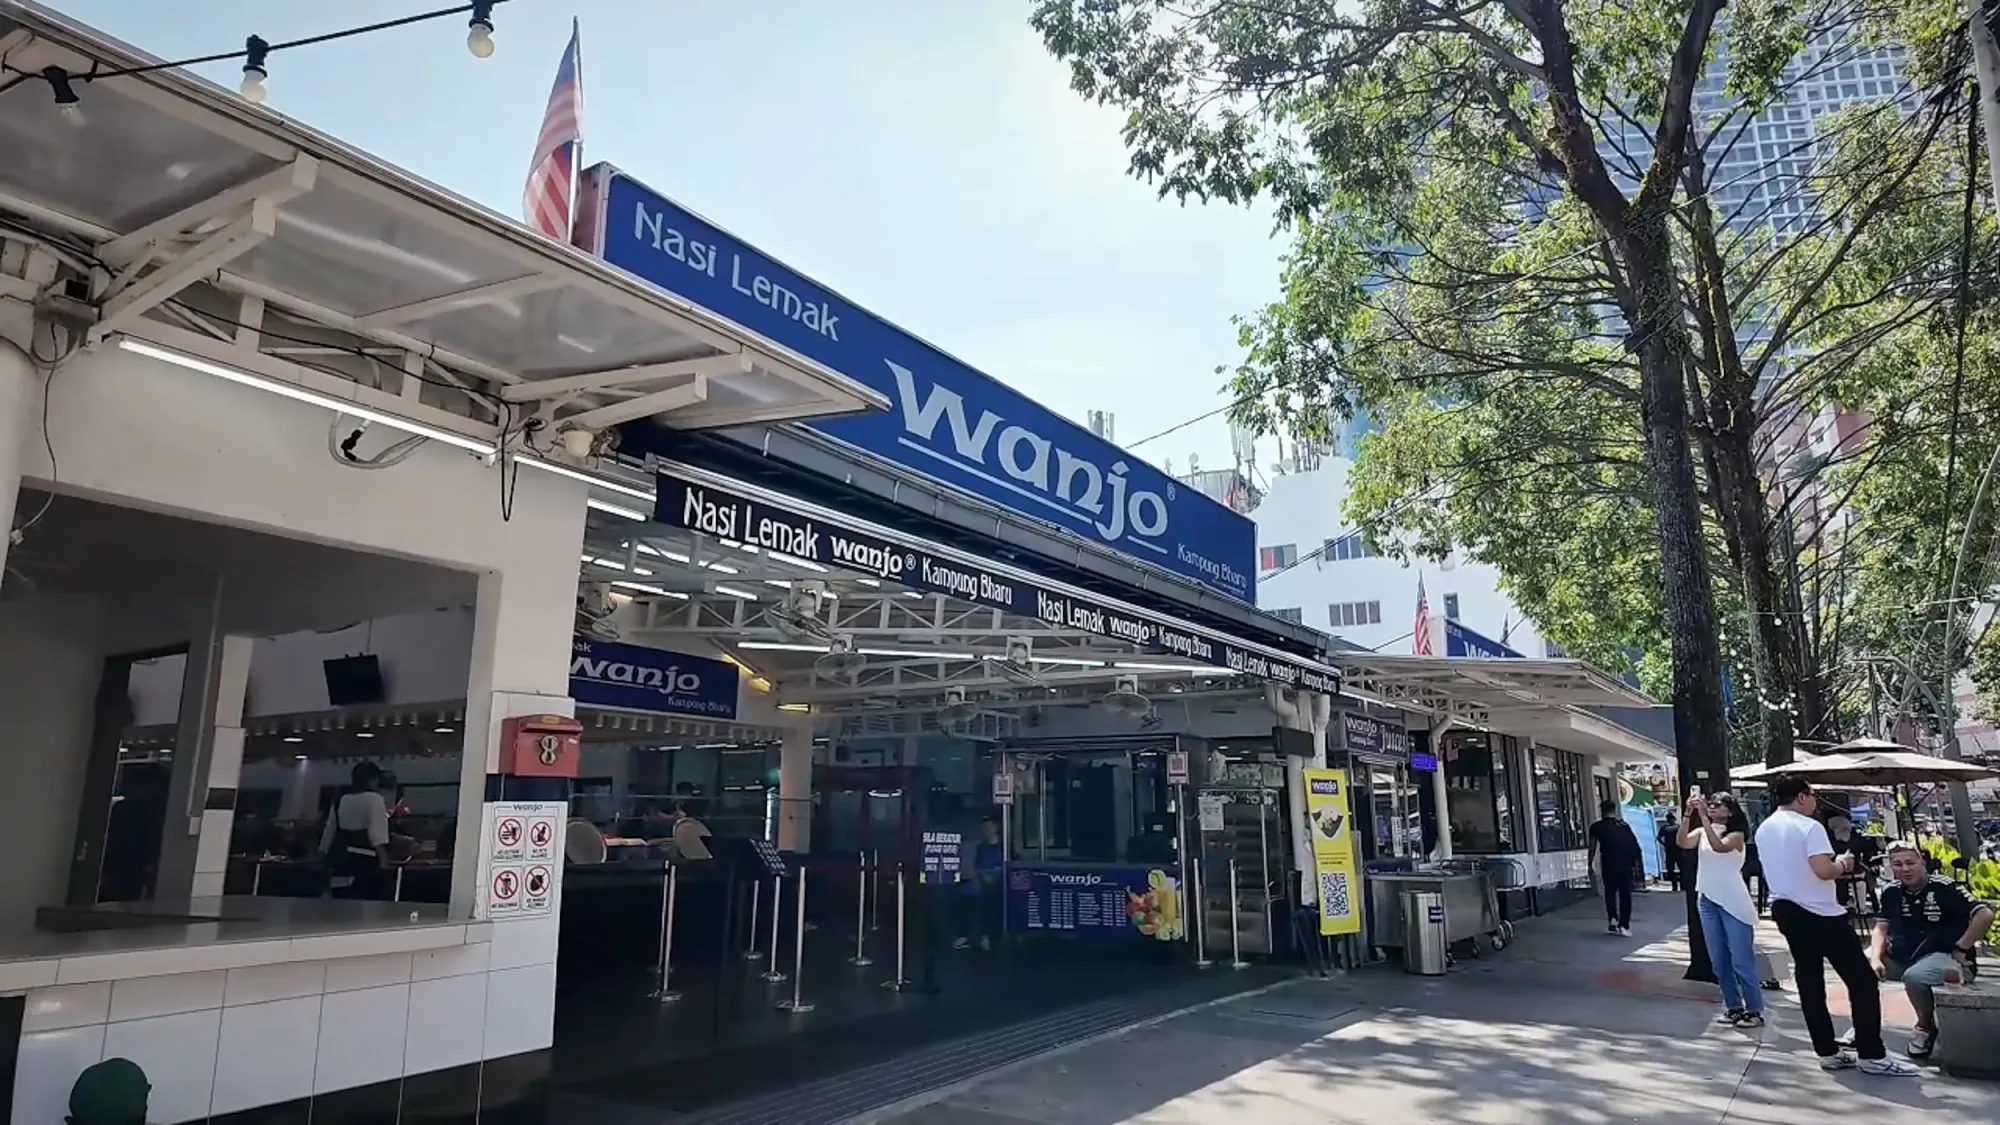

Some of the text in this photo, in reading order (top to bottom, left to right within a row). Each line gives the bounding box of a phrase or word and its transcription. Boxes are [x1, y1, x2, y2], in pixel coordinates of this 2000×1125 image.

[634, 201, 840, 342] Nasi Lemak
[683, 486, 737, 538] Nasi
[744, 505, 820, 560] Lemak
[922, 556, 978, 601] Kampung
[980, 574, 1013, 606] Bharu
[1177, 542, 1220, 581] Kampung
[1221, 563, 1247, 589] Bharu
[1037, 590, 1064, 624] Nasi
[1066, 599, 1106, 635] Lemak
[1158, 625, 1192, 657] Kampung
[1225, 645, 1243, 671] Nasi
[1243, 650, 1269, 678] Lemak
[540, 735, 559, 767] 8
